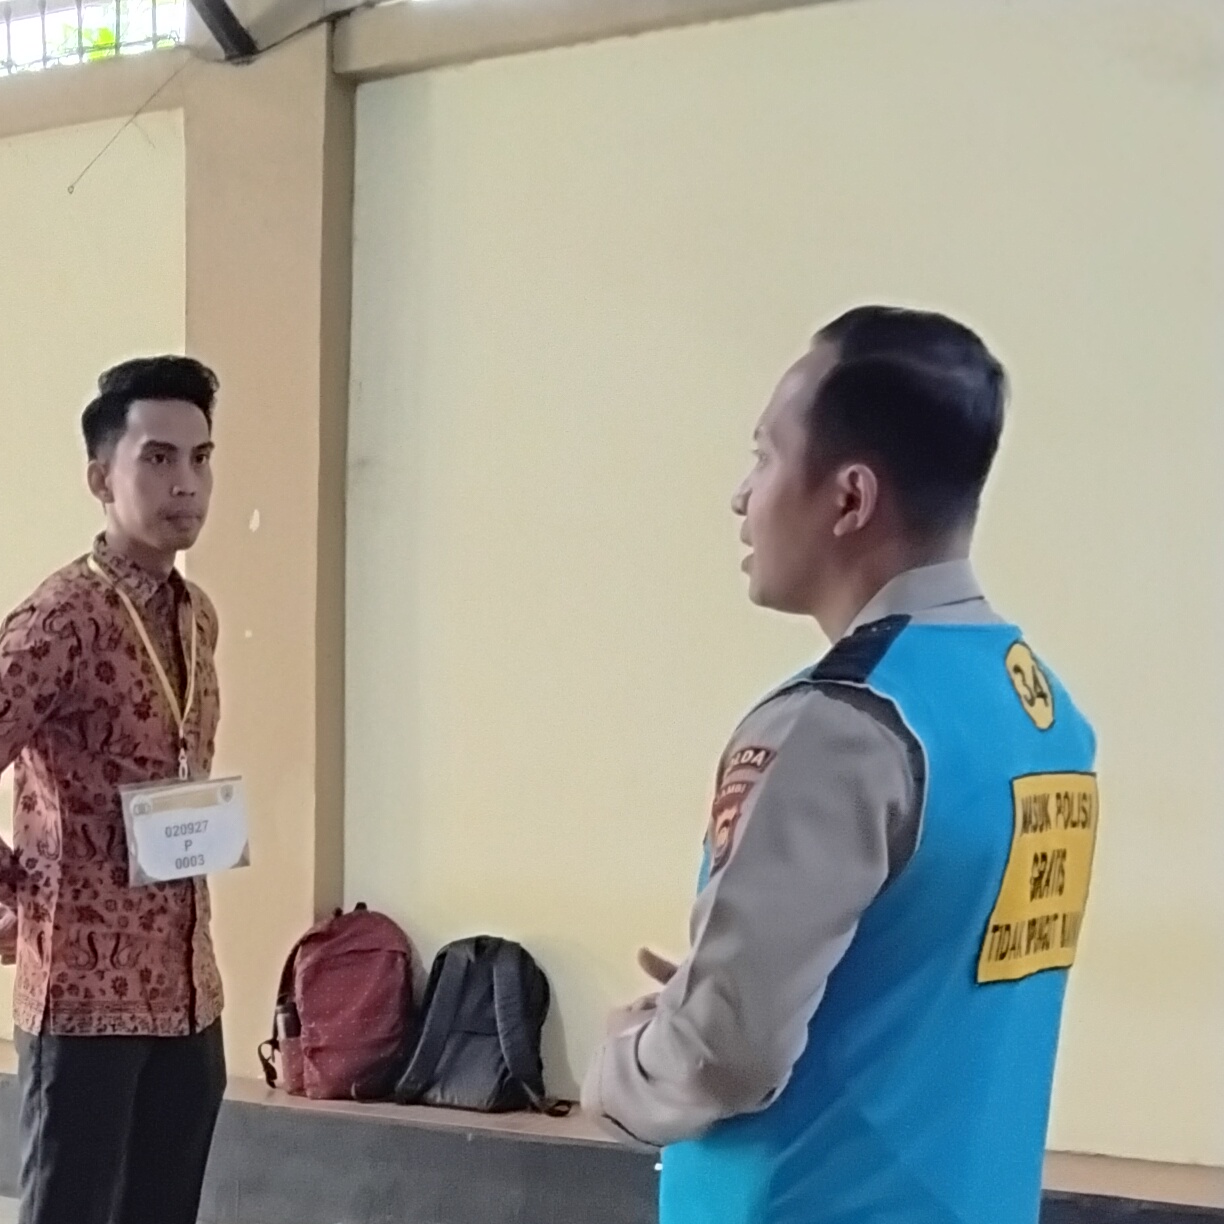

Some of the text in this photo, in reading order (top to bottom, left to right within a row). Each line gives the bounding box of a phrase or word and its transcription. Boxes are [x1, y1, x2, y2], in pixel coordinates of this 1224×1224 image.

[1013, 664, 1049, 708] 34
[1055, 791, 1092, 830] POLISI
[165, 820, 208, 837] 020927
[184, 839, 193, 852] P
[175, 854, 205, 870] 0003
